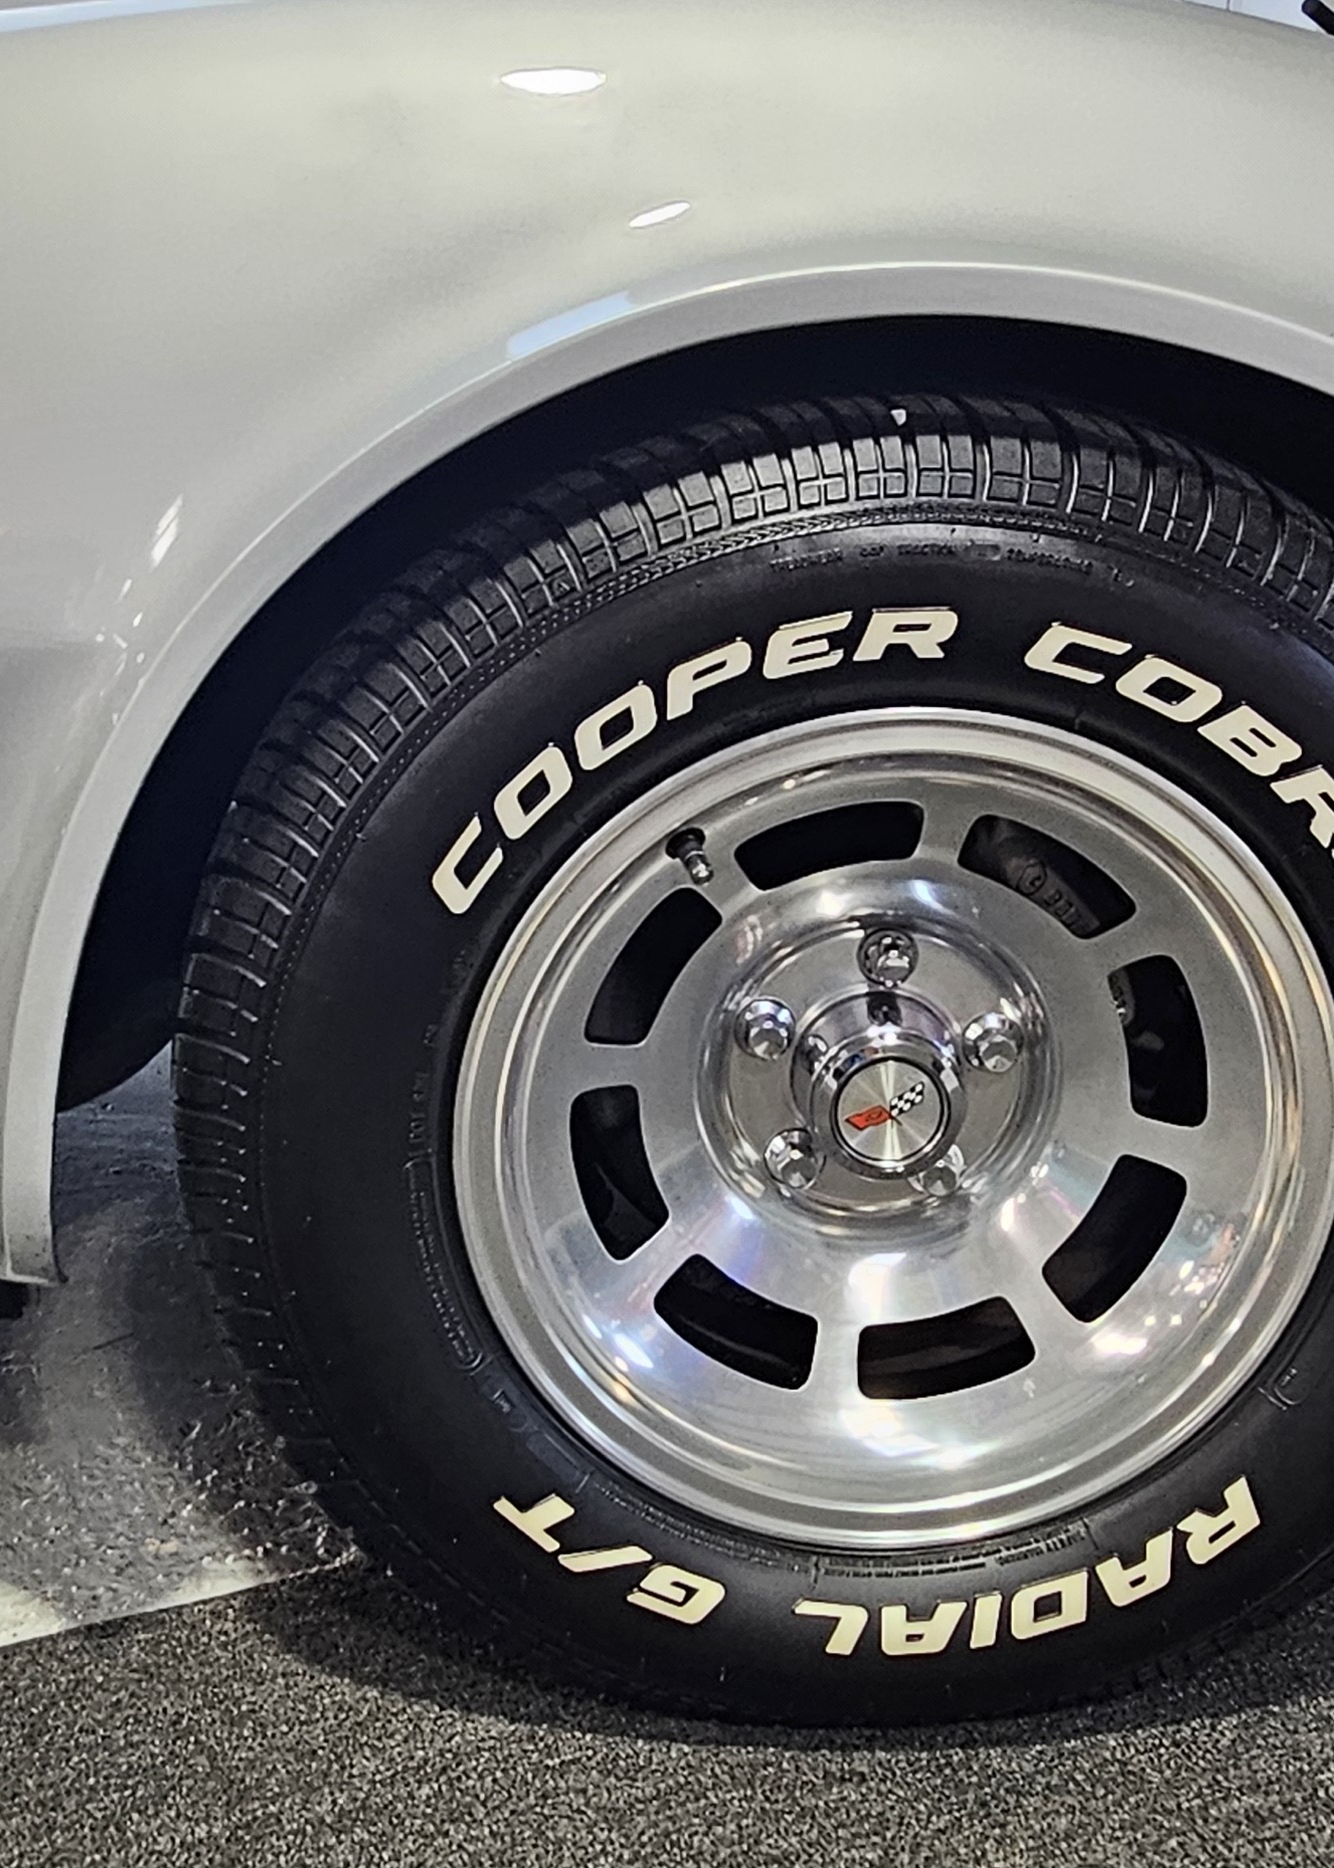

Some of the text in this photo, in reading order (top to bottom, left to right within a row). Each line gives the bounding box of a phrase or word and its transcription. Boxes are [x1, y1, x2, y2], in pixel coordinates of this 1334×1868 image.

[431, 606, 959, 915] COOPER
[493, 1493, 727, 1626] G/T
[791, 1475, 1262, 1656] RADIAL
